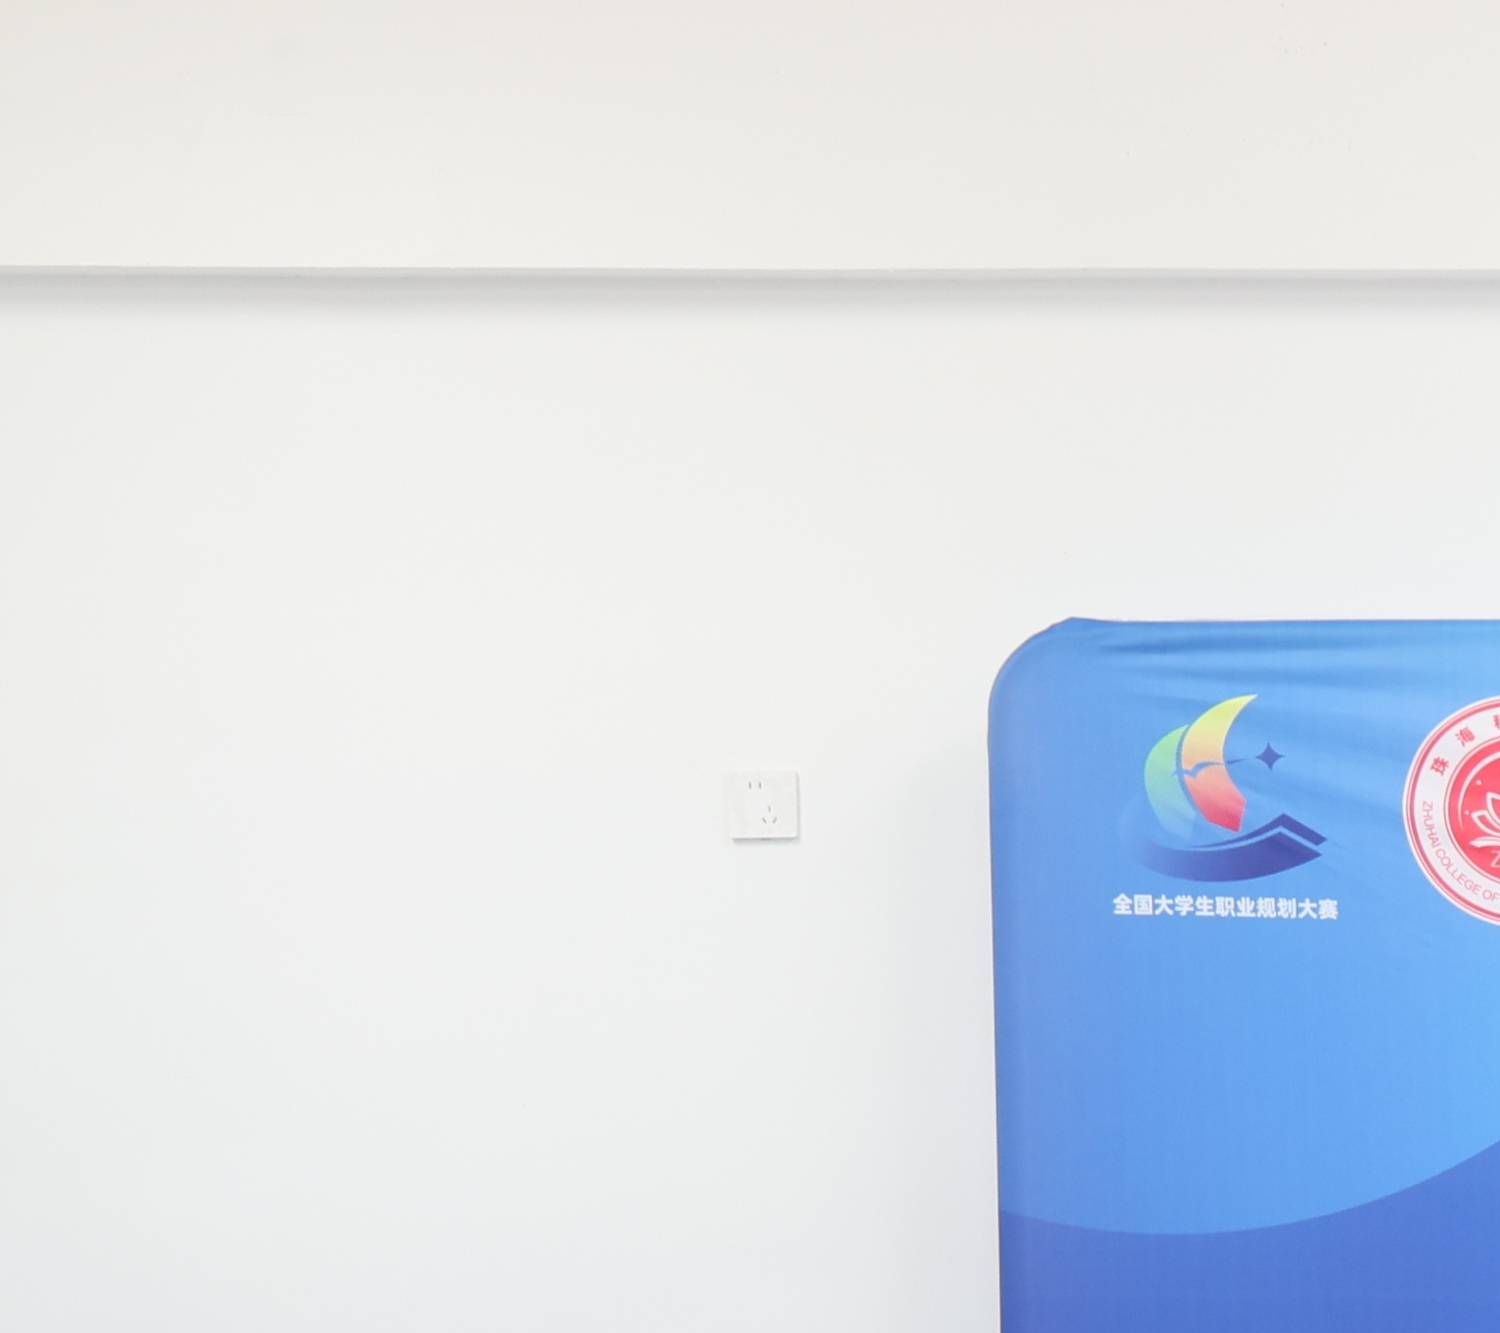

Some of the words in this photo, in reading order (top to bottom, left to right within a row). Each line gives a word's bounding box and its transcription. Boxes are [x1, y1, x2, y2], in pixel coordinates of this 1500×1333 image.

[1422, 800, 1439, 850] ZHUHAI
[1436, 849, 1481, 895] COLLEGE
[1482, 889, 1500, 902] OF
[1113, 892, 1339, 920] 全国大学生职业规划大赛
